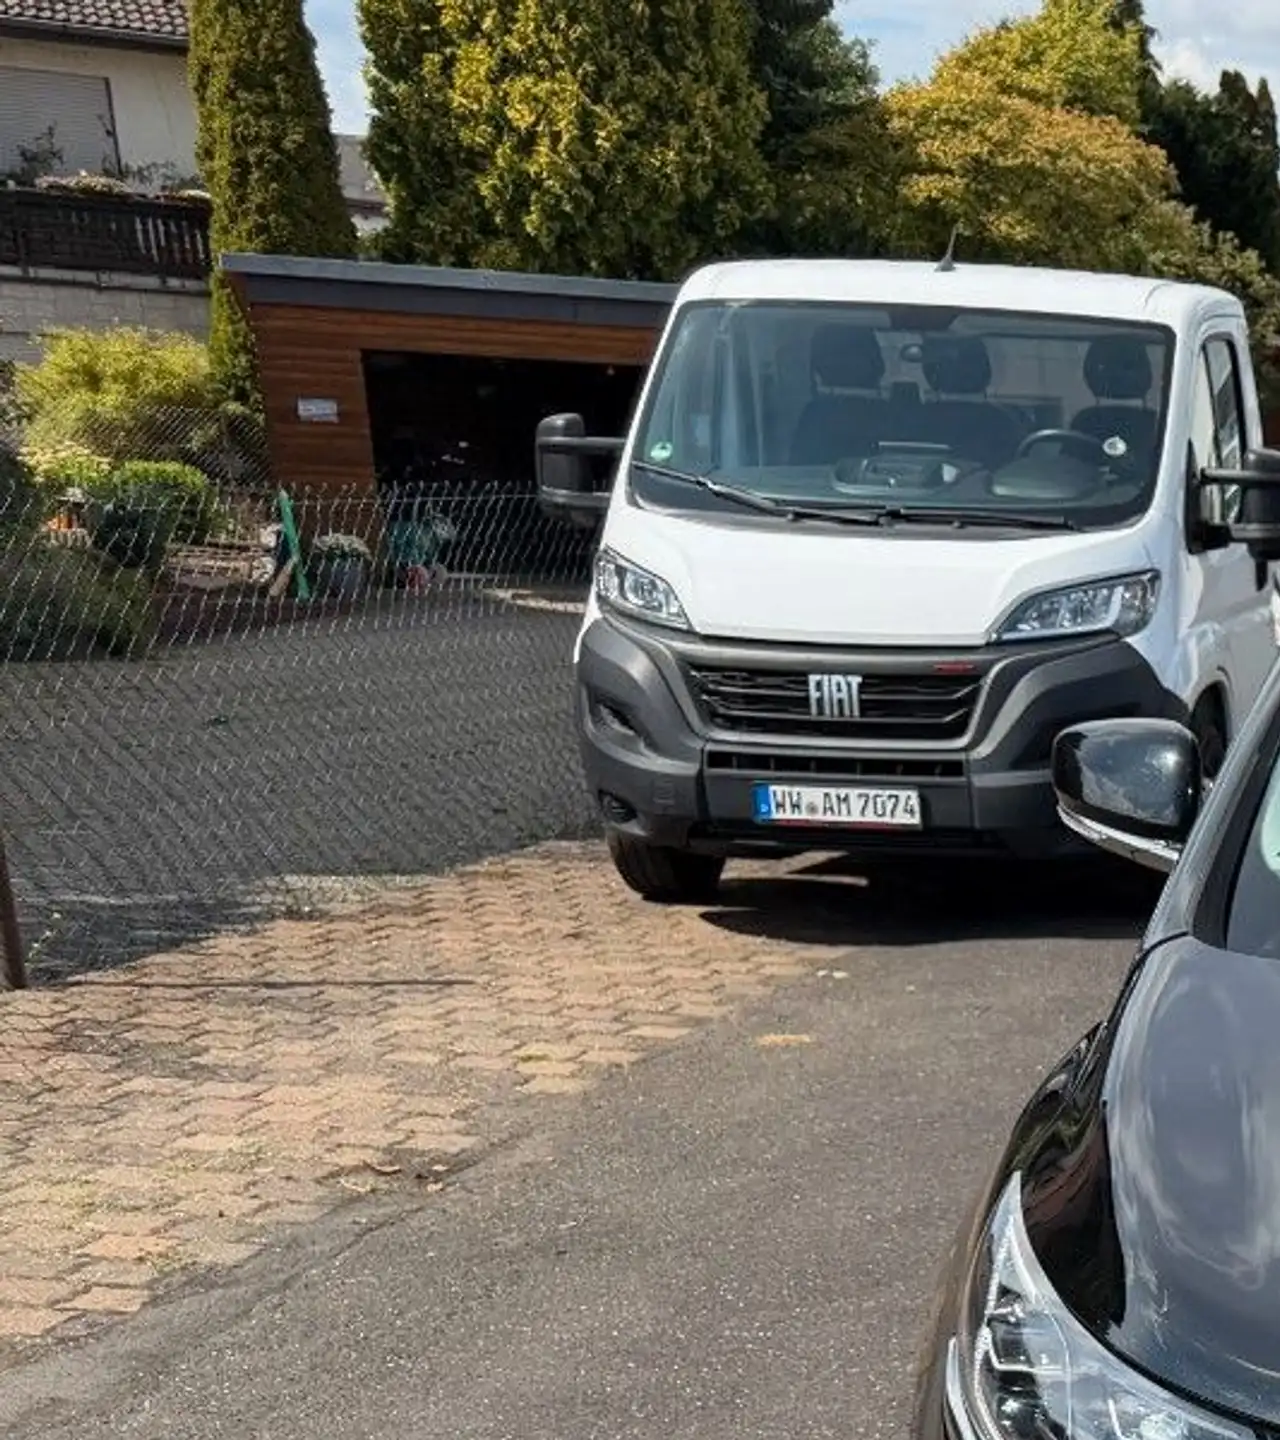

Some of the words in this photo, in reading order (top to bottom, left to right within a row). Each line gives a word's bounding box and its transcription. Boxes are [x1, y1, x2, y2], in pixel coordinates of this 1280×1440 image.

[808, 674, 863, 719] FIAT
[772, 789, 803, 815] WW
[822, 792, 852, 816] AM
[857, 794, 917, 820] 7074
